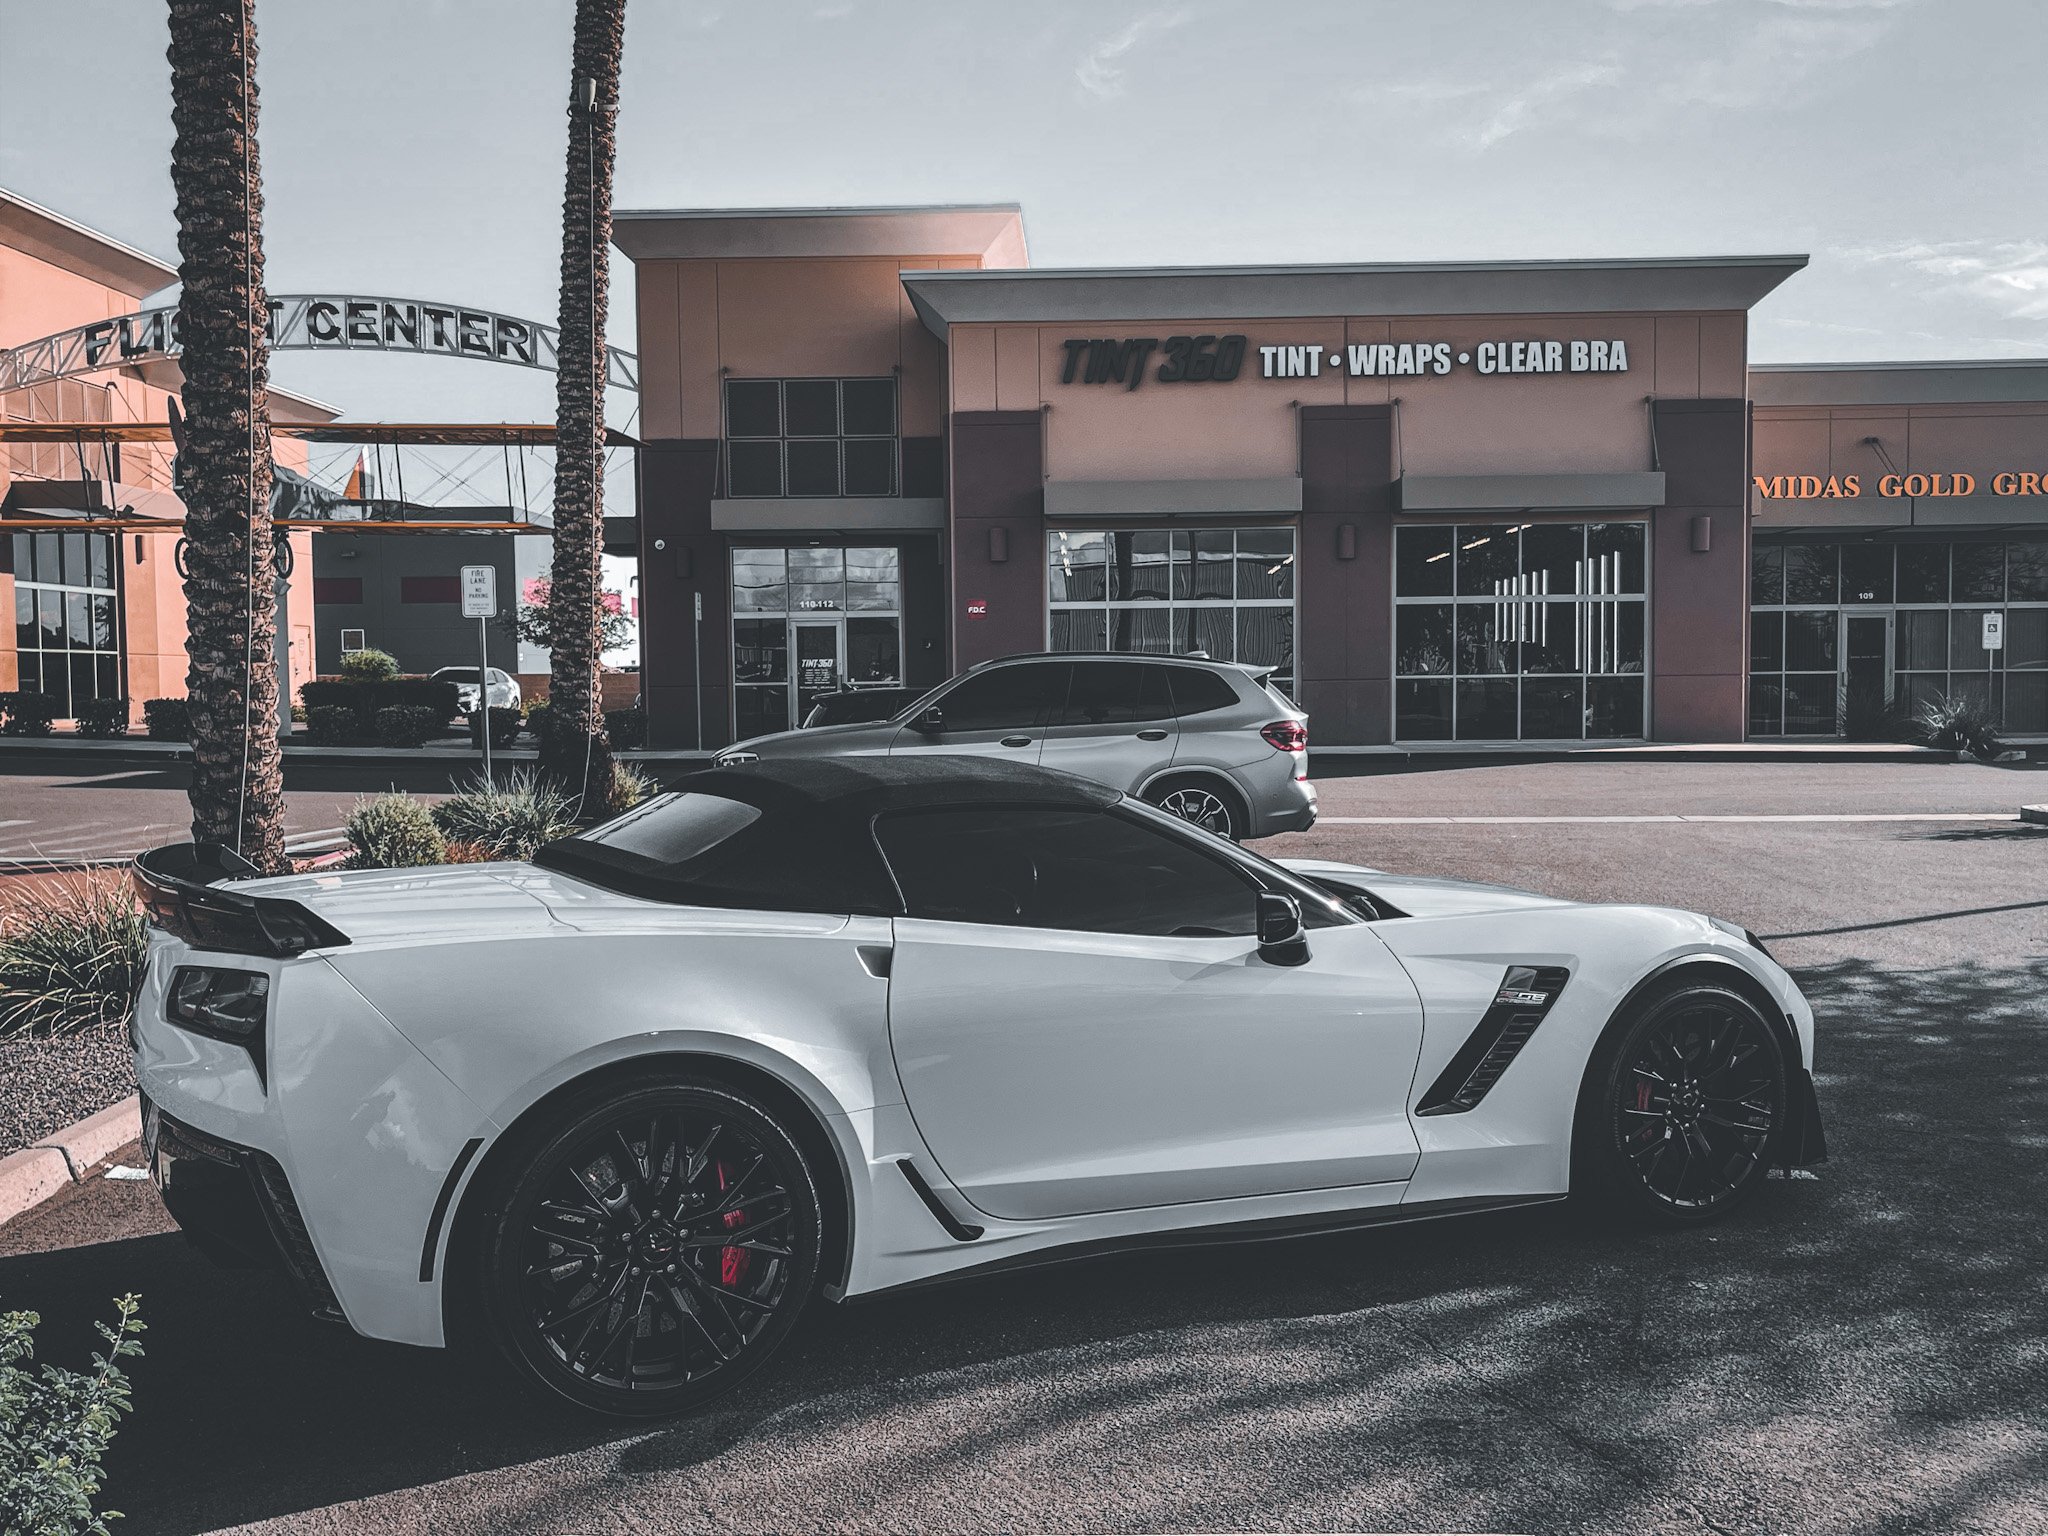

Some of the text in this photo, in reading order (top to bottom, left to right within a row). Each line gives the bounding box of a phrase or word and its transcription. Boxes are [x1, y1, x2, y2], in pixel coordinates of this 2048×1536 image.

[307, 302, 530, 363] CENTER
[1062, 335, 1247, 392] TINT 360
[1260, 340, 1628, 377] TINT WRAPS CLEAR BRA
[1754, 472, 2048, 499] MIDAS GOLD GR
[1858, 592, 1874, 600] 109
[801, 659, 834, 668] TINT 360
